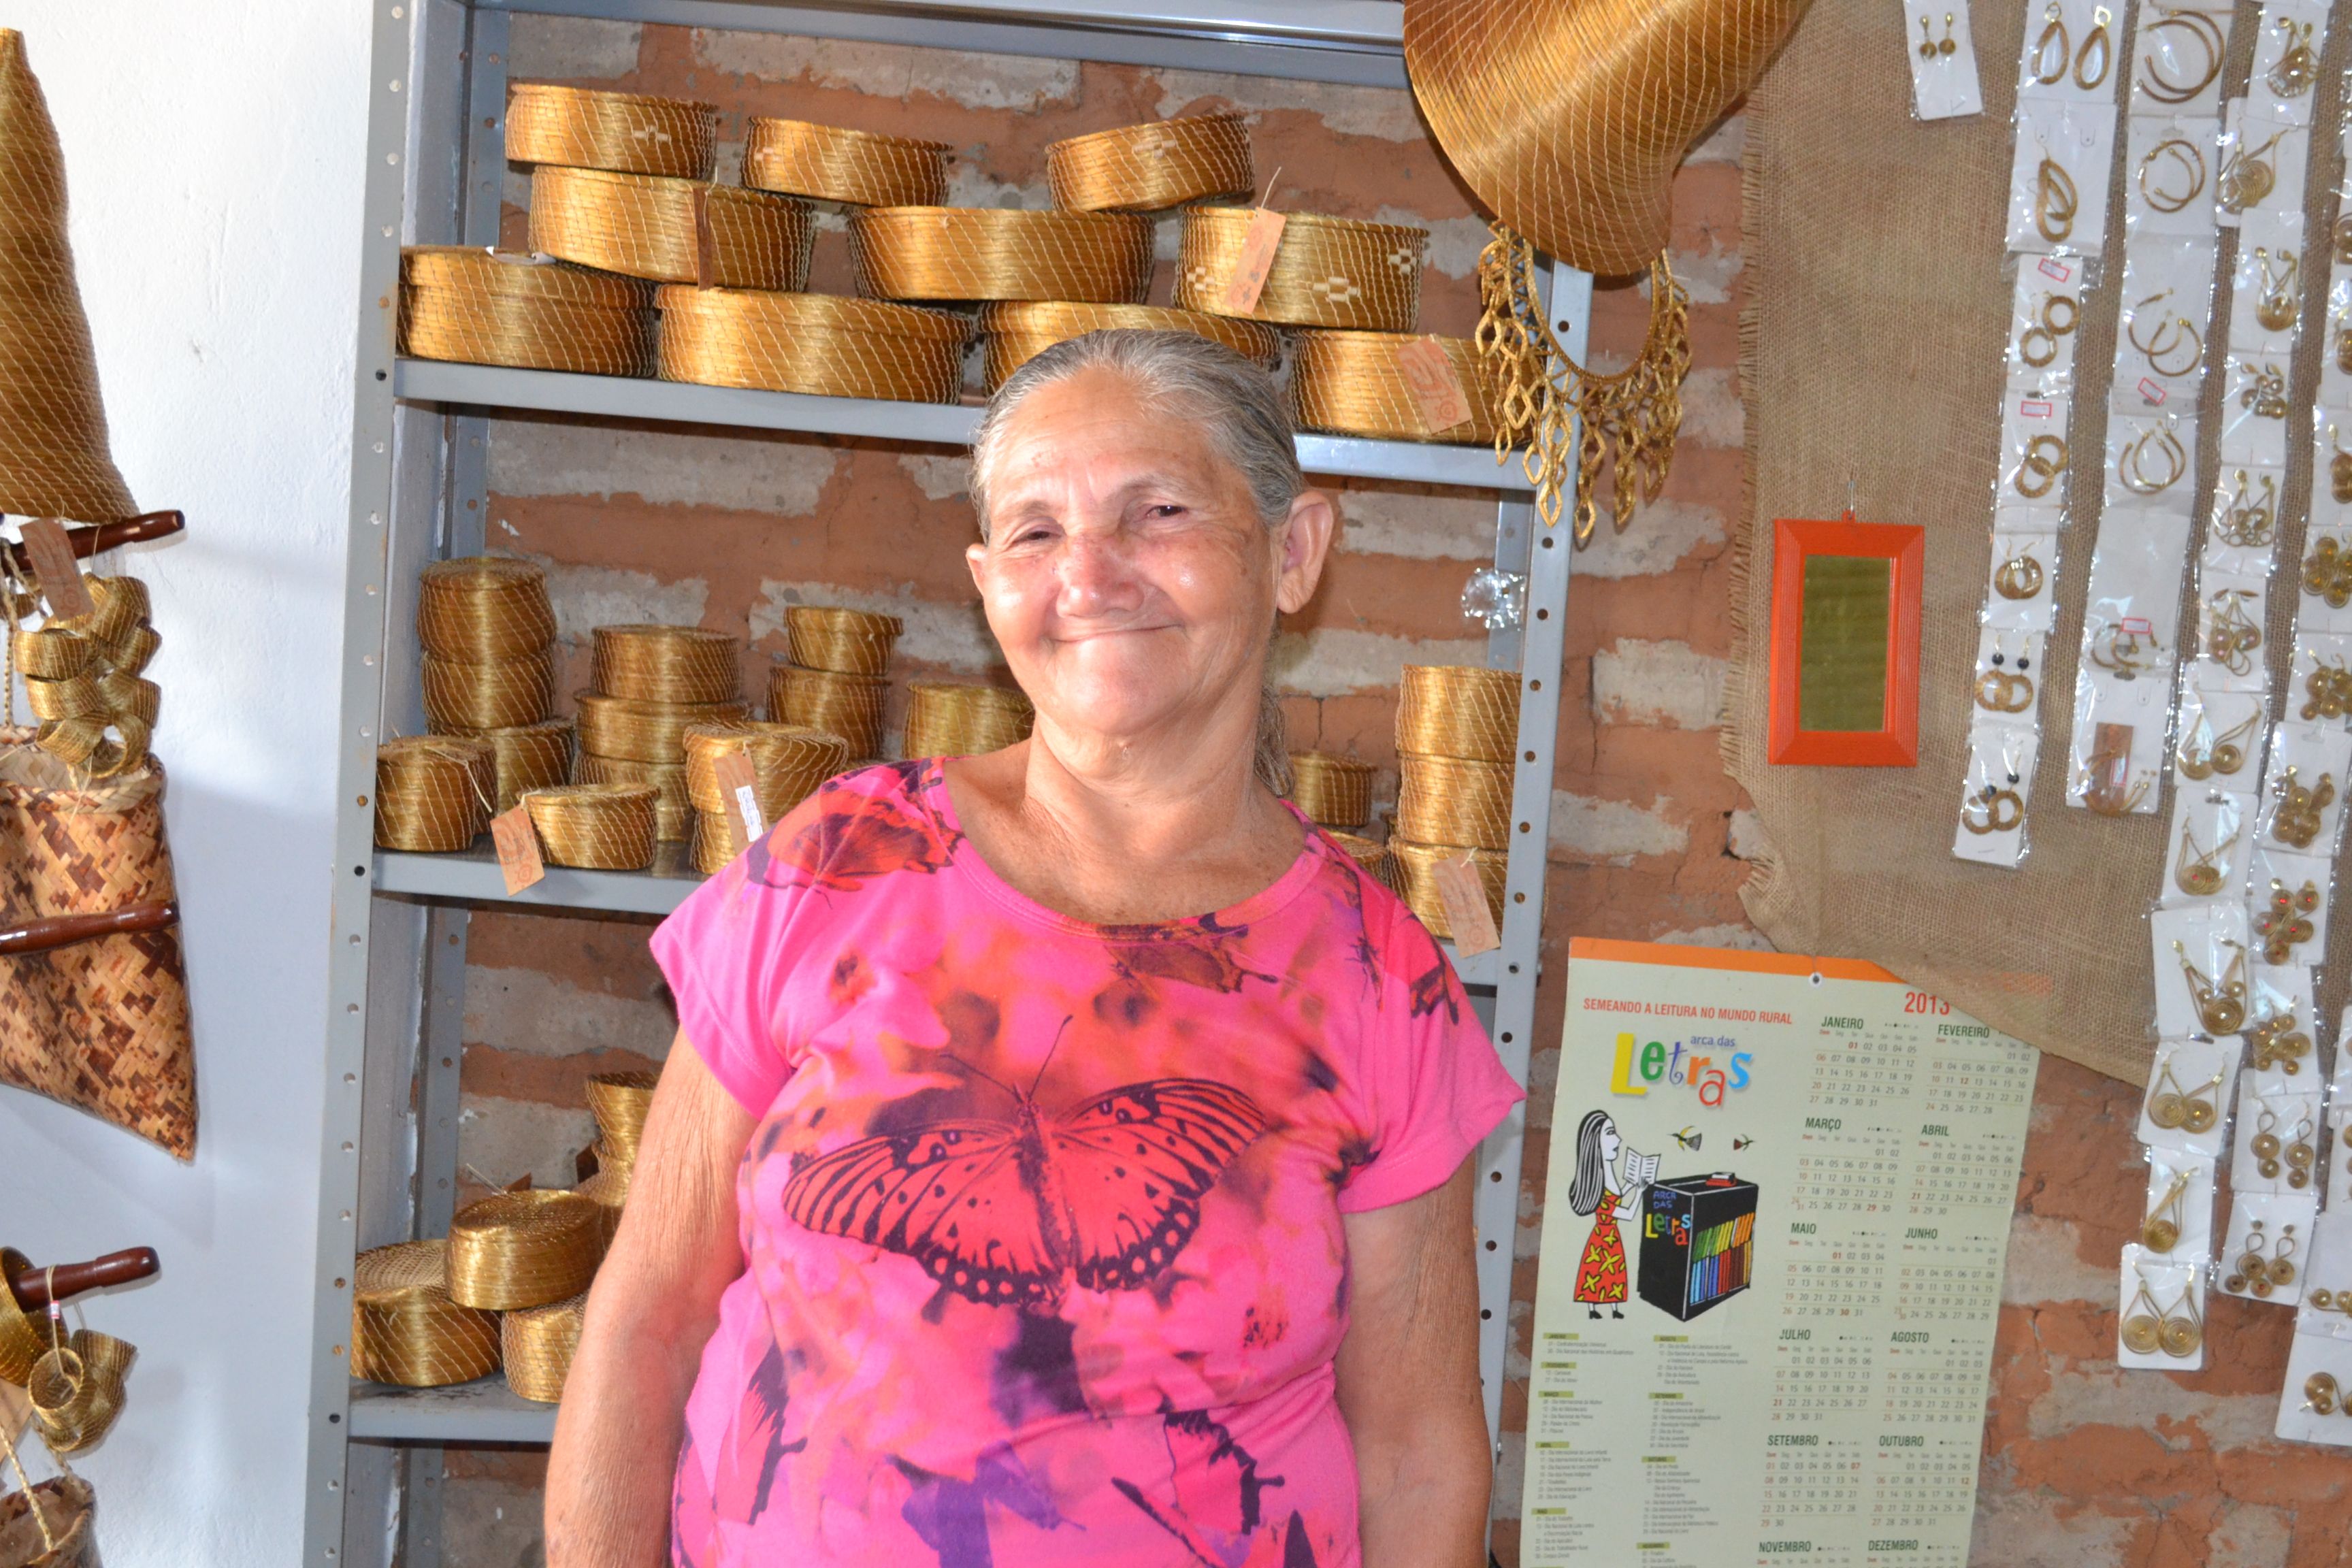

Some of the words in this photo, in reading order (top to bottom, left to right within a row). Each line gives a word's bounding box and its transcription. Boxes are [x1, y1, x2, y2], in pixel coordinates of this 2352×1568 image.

[1584, 998, 1642, 1013] SEMEANDO
[1645, 1003, 1651, 1014] A
[1655, 1004, 1697, 1017] LEITURA
[1701, 1007, 1714, 1018] NO
[1718, 1009, 1755, 1022] MUNDO
[1759, 1011, 1792, 1024] RURAL
[1821, 1017, 1863, 1029] JANEIRO
[1938, 1024, 1989, 1038] FEVEREIRO
[1690, 1036, 1714, 1045] arca
[1717, 1036, 1735, 1047] das
[1610, 1032, 1752, 1107] Letras
[1805, 1117, 1842, 1132] MARÇO
[1921, 1125, 1949, 1137] ABRIL
[1653, 1190, 1677, 1200] ARCA
[1654, 1200, 1673, 1209] DAS
[1646, 1213, 1692, 1246] Letras
[1791, 1223, 1816, 1234] MAIO
[1906, 1228, 1938, 1239] JUNHO
[1779, 1329, 1810, 1339] JULHO
[1891, 1332, 1929, 1343] AGOSTO
[1767, 1435, 1818, 1446] SETEMBRO
[1880, 1436, 1923, 1446] OUTUBRO
[1759, 1541, 1811, 1552] NOVEMBRO
[1868, 1540, 1918, 1551] DEZEMBRO
